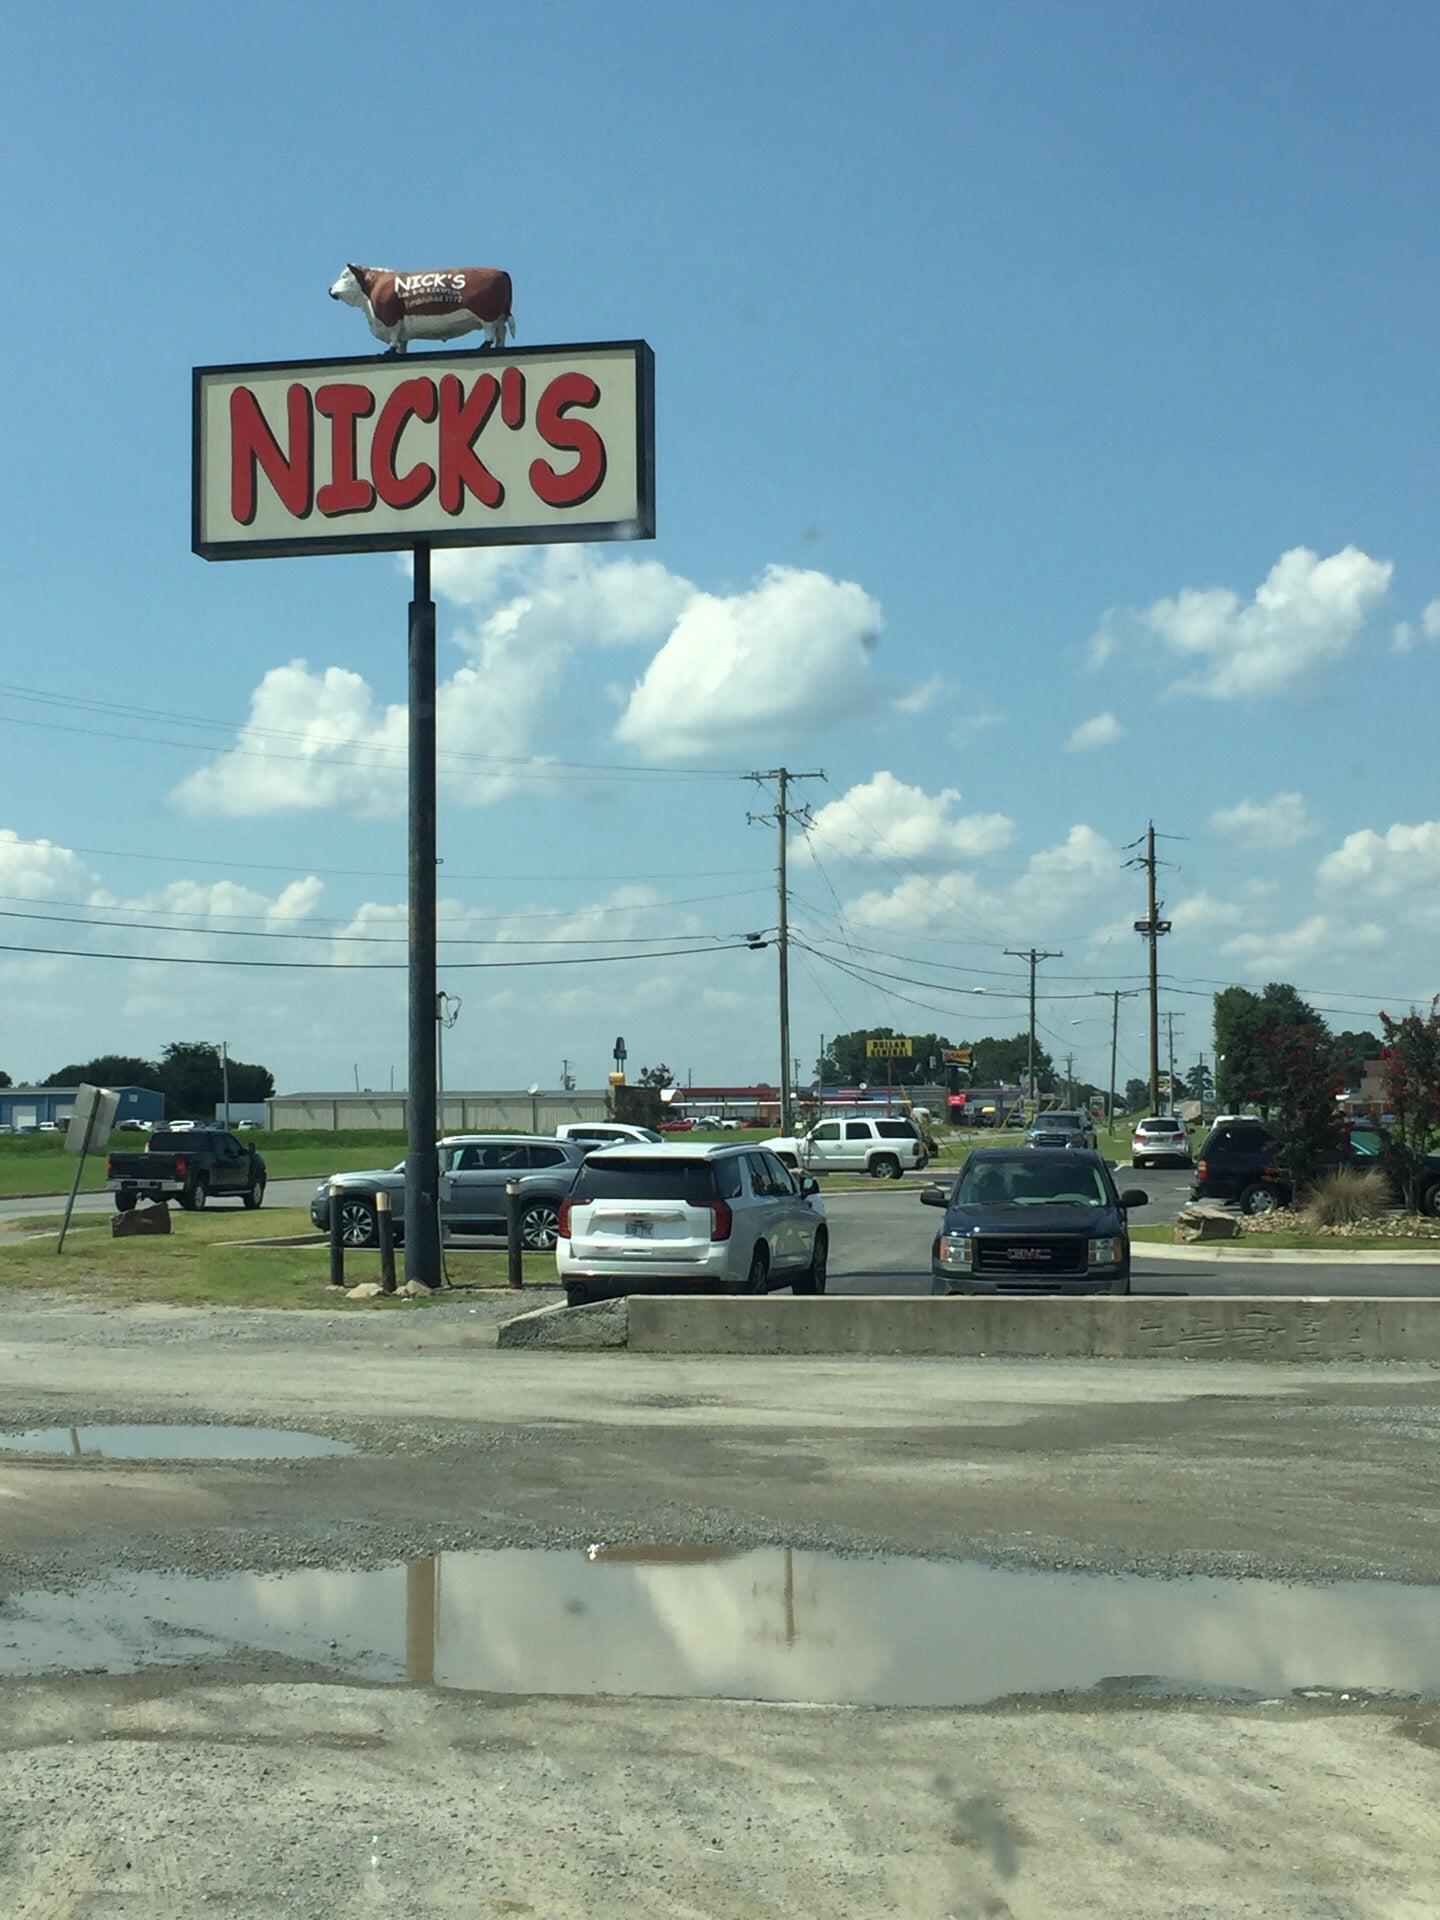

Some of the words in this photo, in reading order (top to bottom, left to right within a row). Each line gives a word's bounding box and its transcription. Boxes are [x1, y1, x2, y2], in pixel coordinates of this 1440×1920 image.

[395, 272, 466, 292] NICK'S
[230, 366, 607, 525] NICK'S
[873, 1041, 906, 1049] DOLLAR
[1007, 1248, 1052, 1260] GMC
